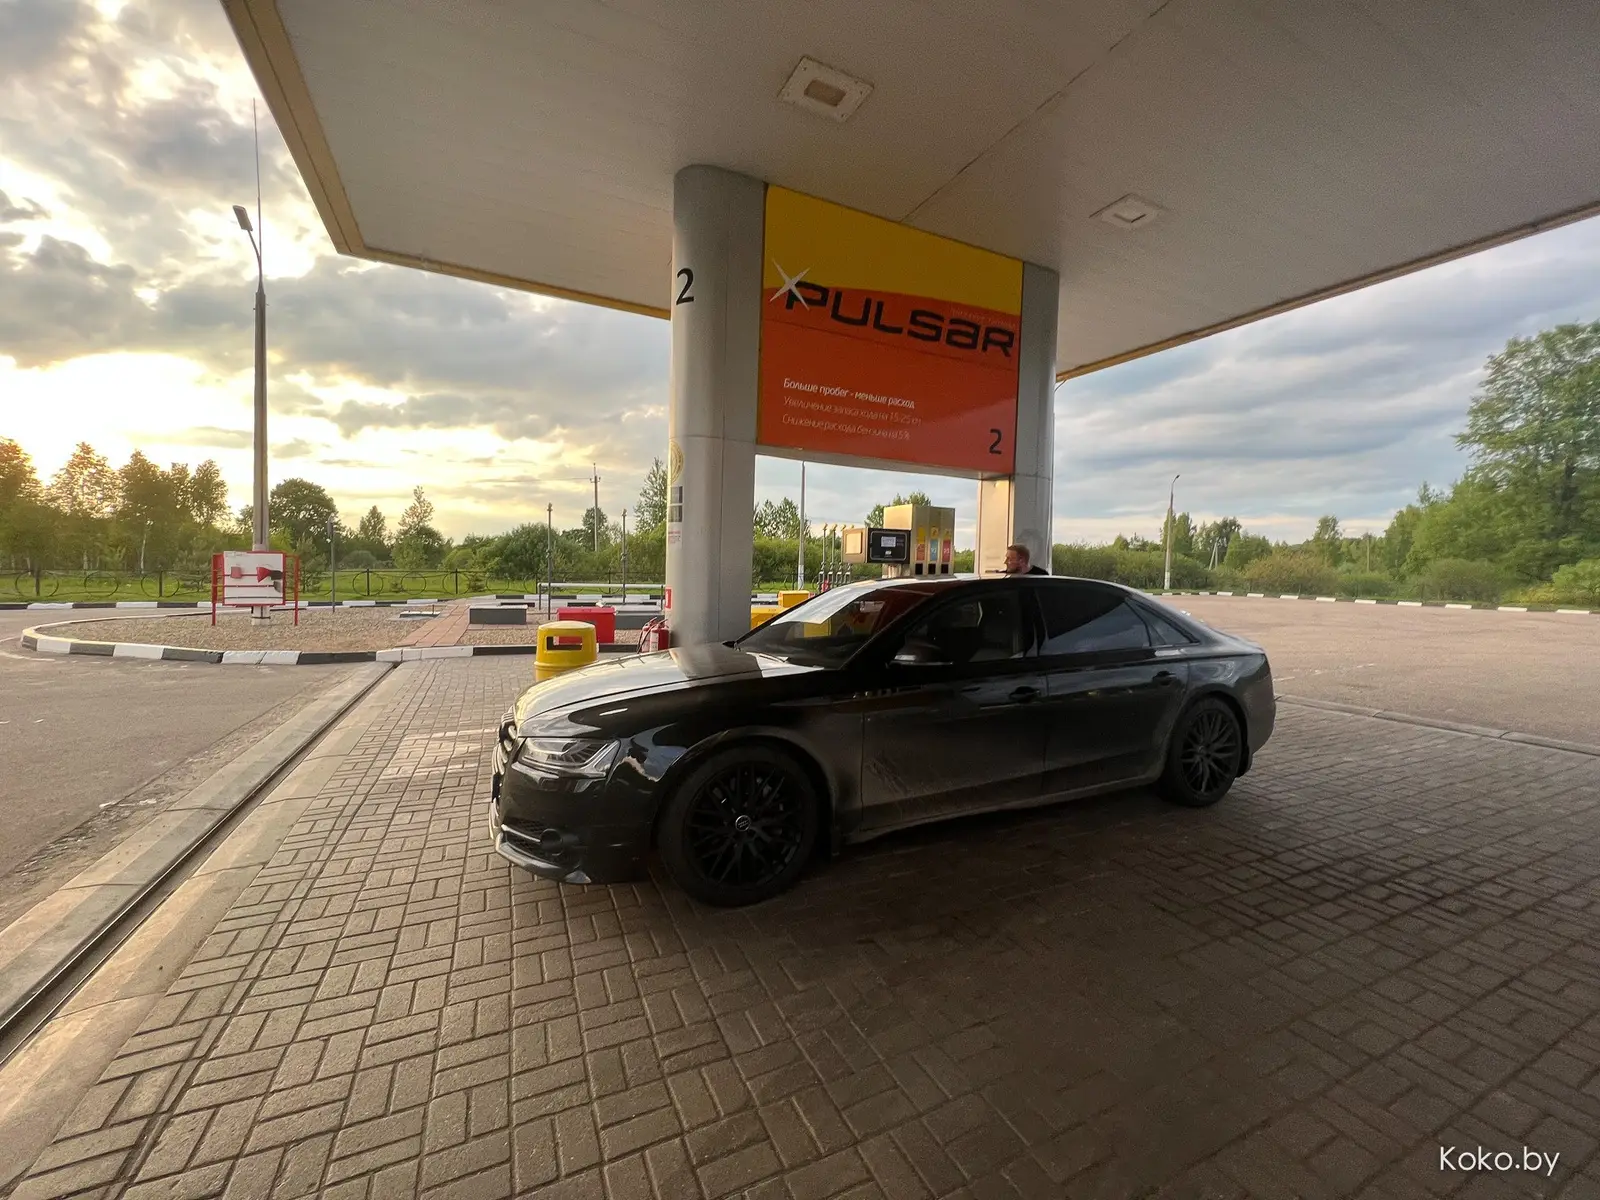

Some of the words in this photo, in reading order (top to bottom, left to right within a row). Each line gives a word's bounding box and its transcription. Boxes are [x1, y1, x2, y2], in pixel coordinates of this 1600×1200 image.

[676, 268, 694, 305] 2
[783, 378, 818, 394] Больше
[819, 384, 849, 398] пробег
[855, 390, 887, 404] меньше
[888, 396, 915, 410] расход
[989, 428, 1002, 455] 2
